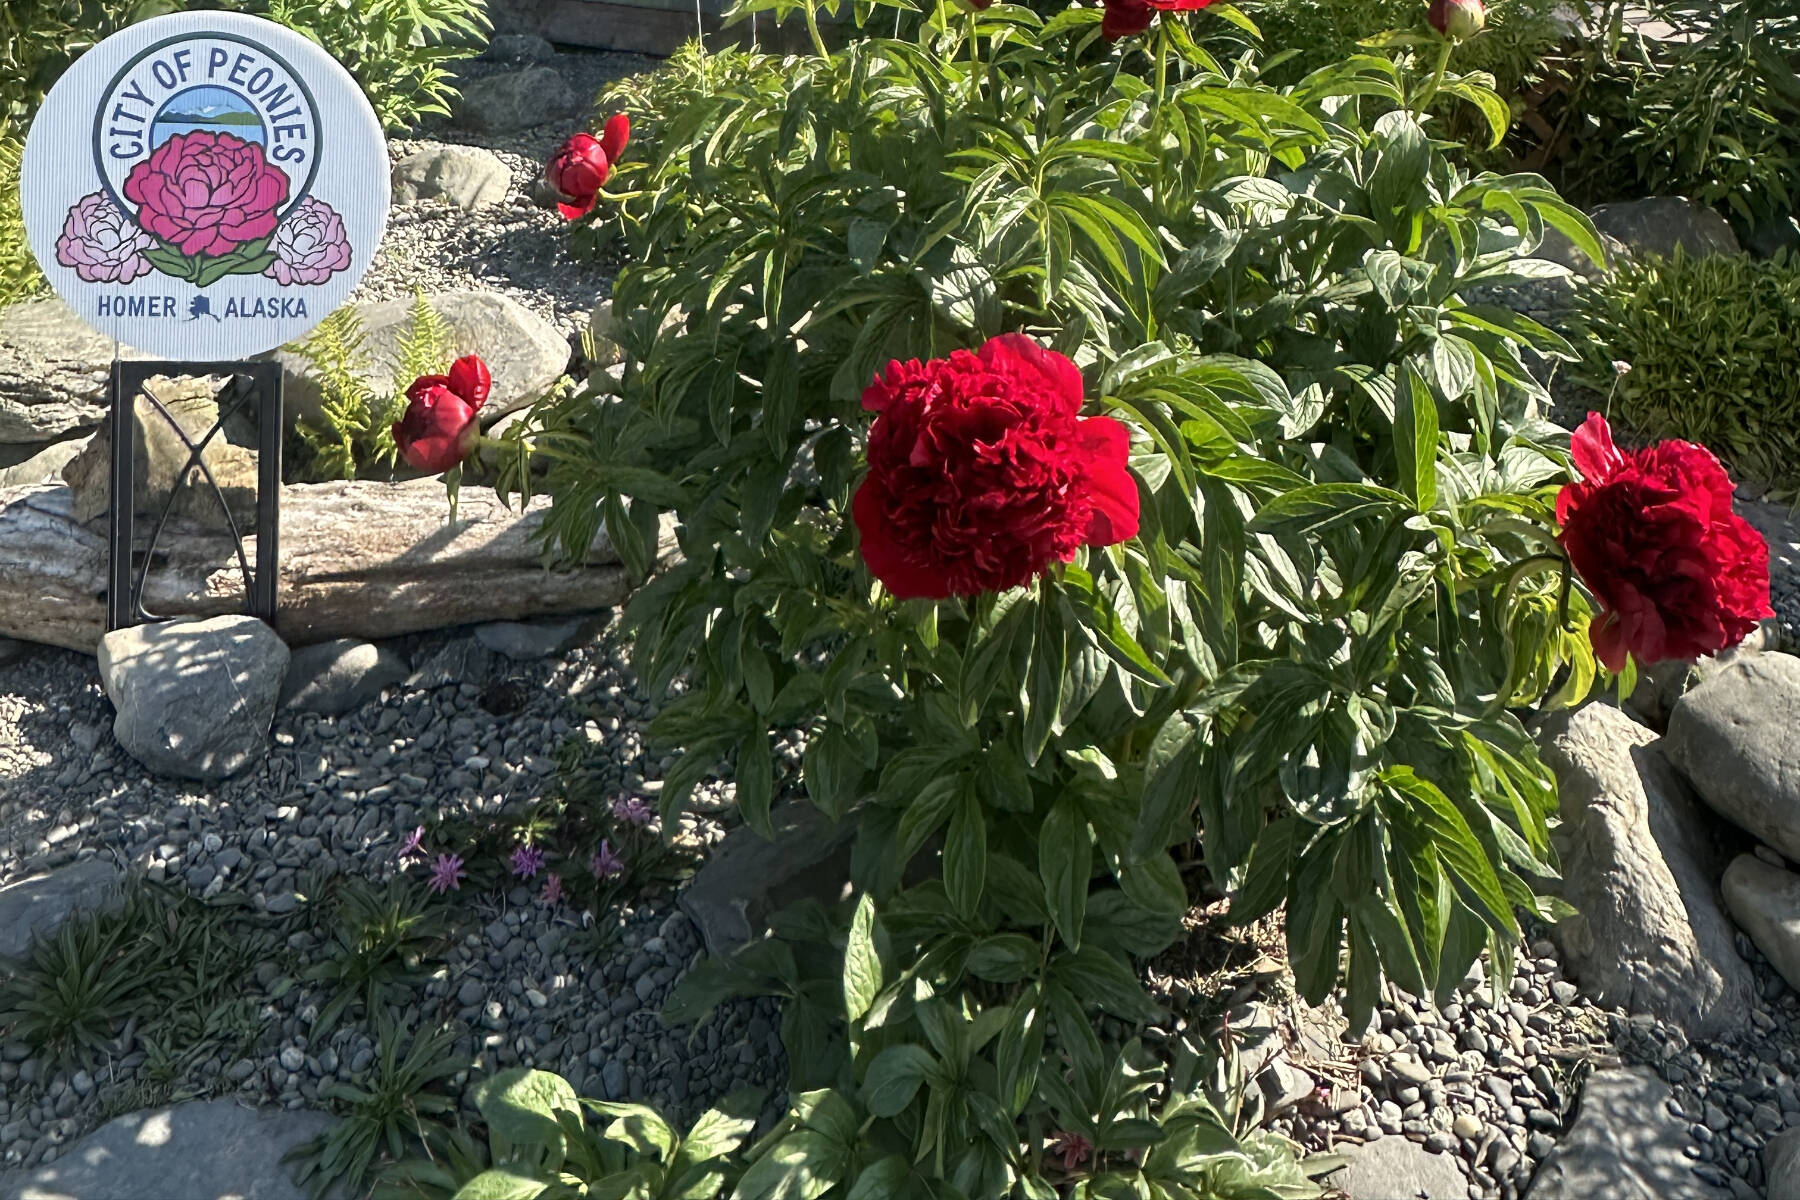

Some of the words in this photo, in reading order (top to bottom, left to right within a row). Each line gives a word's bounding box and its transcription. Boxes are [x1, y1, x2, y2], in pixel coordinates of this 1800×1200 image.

[109, 79, 155, 160] CITY
[152, 49, 192, 90] OF
[207, 47, 307, 164] PEONIES
[97, 295, 177, 318] HOMER
[224, 296, 308, 319] ALASKA
